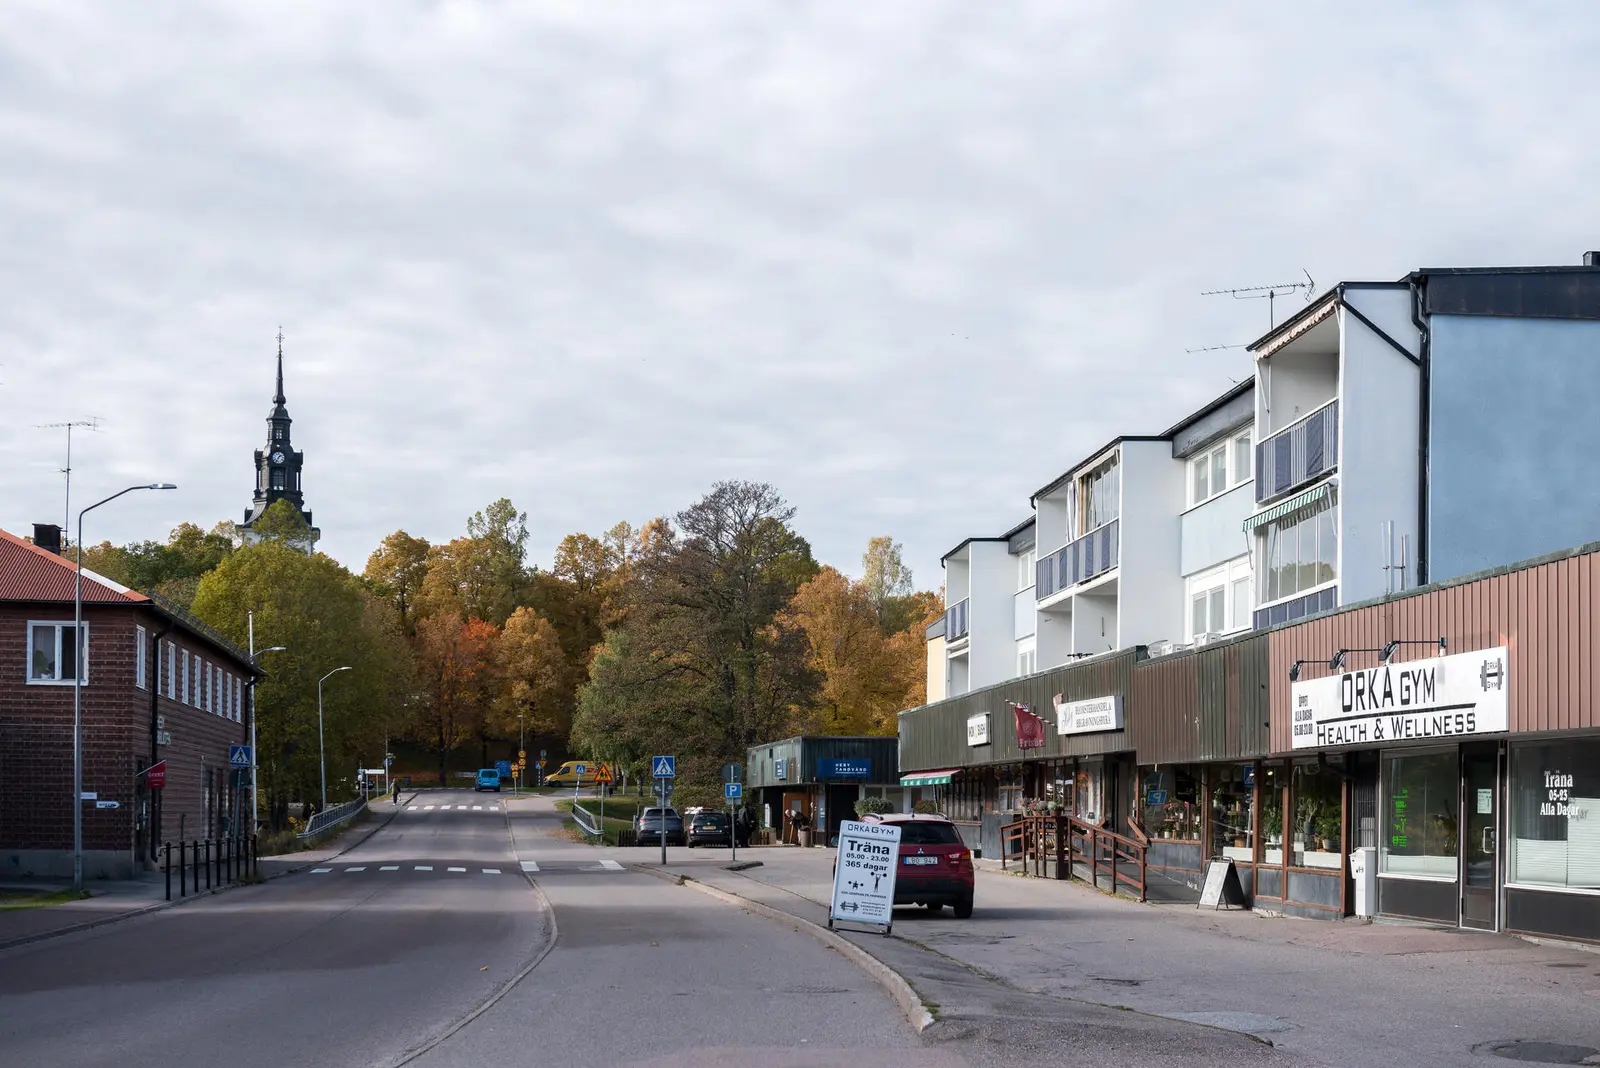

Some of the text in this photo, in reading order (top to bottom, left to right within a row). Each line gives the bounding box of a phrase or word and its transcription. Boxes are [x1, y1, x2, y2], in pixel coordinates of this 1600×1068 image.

[1341, 666, 1436, 713] ORKA GYM
[1316, 712, 1477, 746] HEALTH & WELLNESS
[1544, 769, 1573, 788] Träna
[729, 785, 737, 796] P
[1548, 789, 1568, 801] 05-23
[1540, 802, 1580, 819] Alla Dagar
[847, 839, 890, 855] Träna
[846, 852, 865, 860] 05.00
[870, 855, 890, 863] 23.00
[845, 860, 888, 872] 365 dagar
